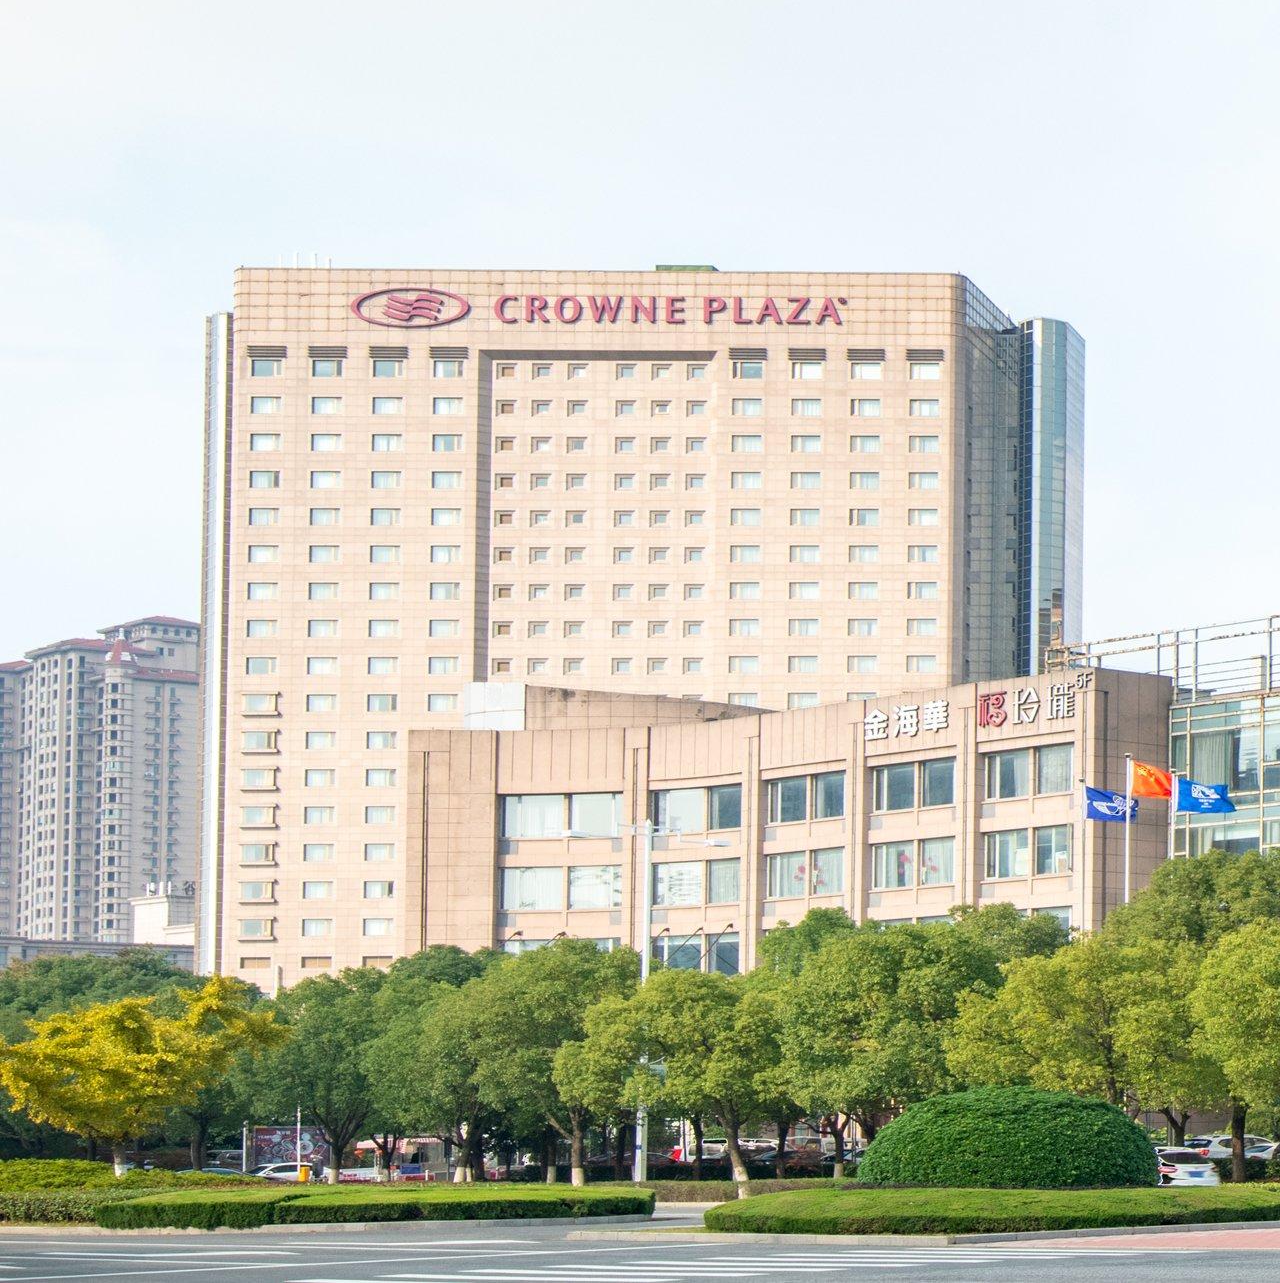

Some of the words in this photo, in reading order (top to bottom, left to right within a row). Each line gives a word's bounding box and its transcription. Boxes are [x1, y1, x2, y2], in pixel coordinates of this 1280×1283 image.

[494, 294, 686, 325] CROWNE
[703, 295, 844, 326] PLAZA
[1075, 672, 1094, 690] 5F
[864, 700, 949, 741] 金海華
